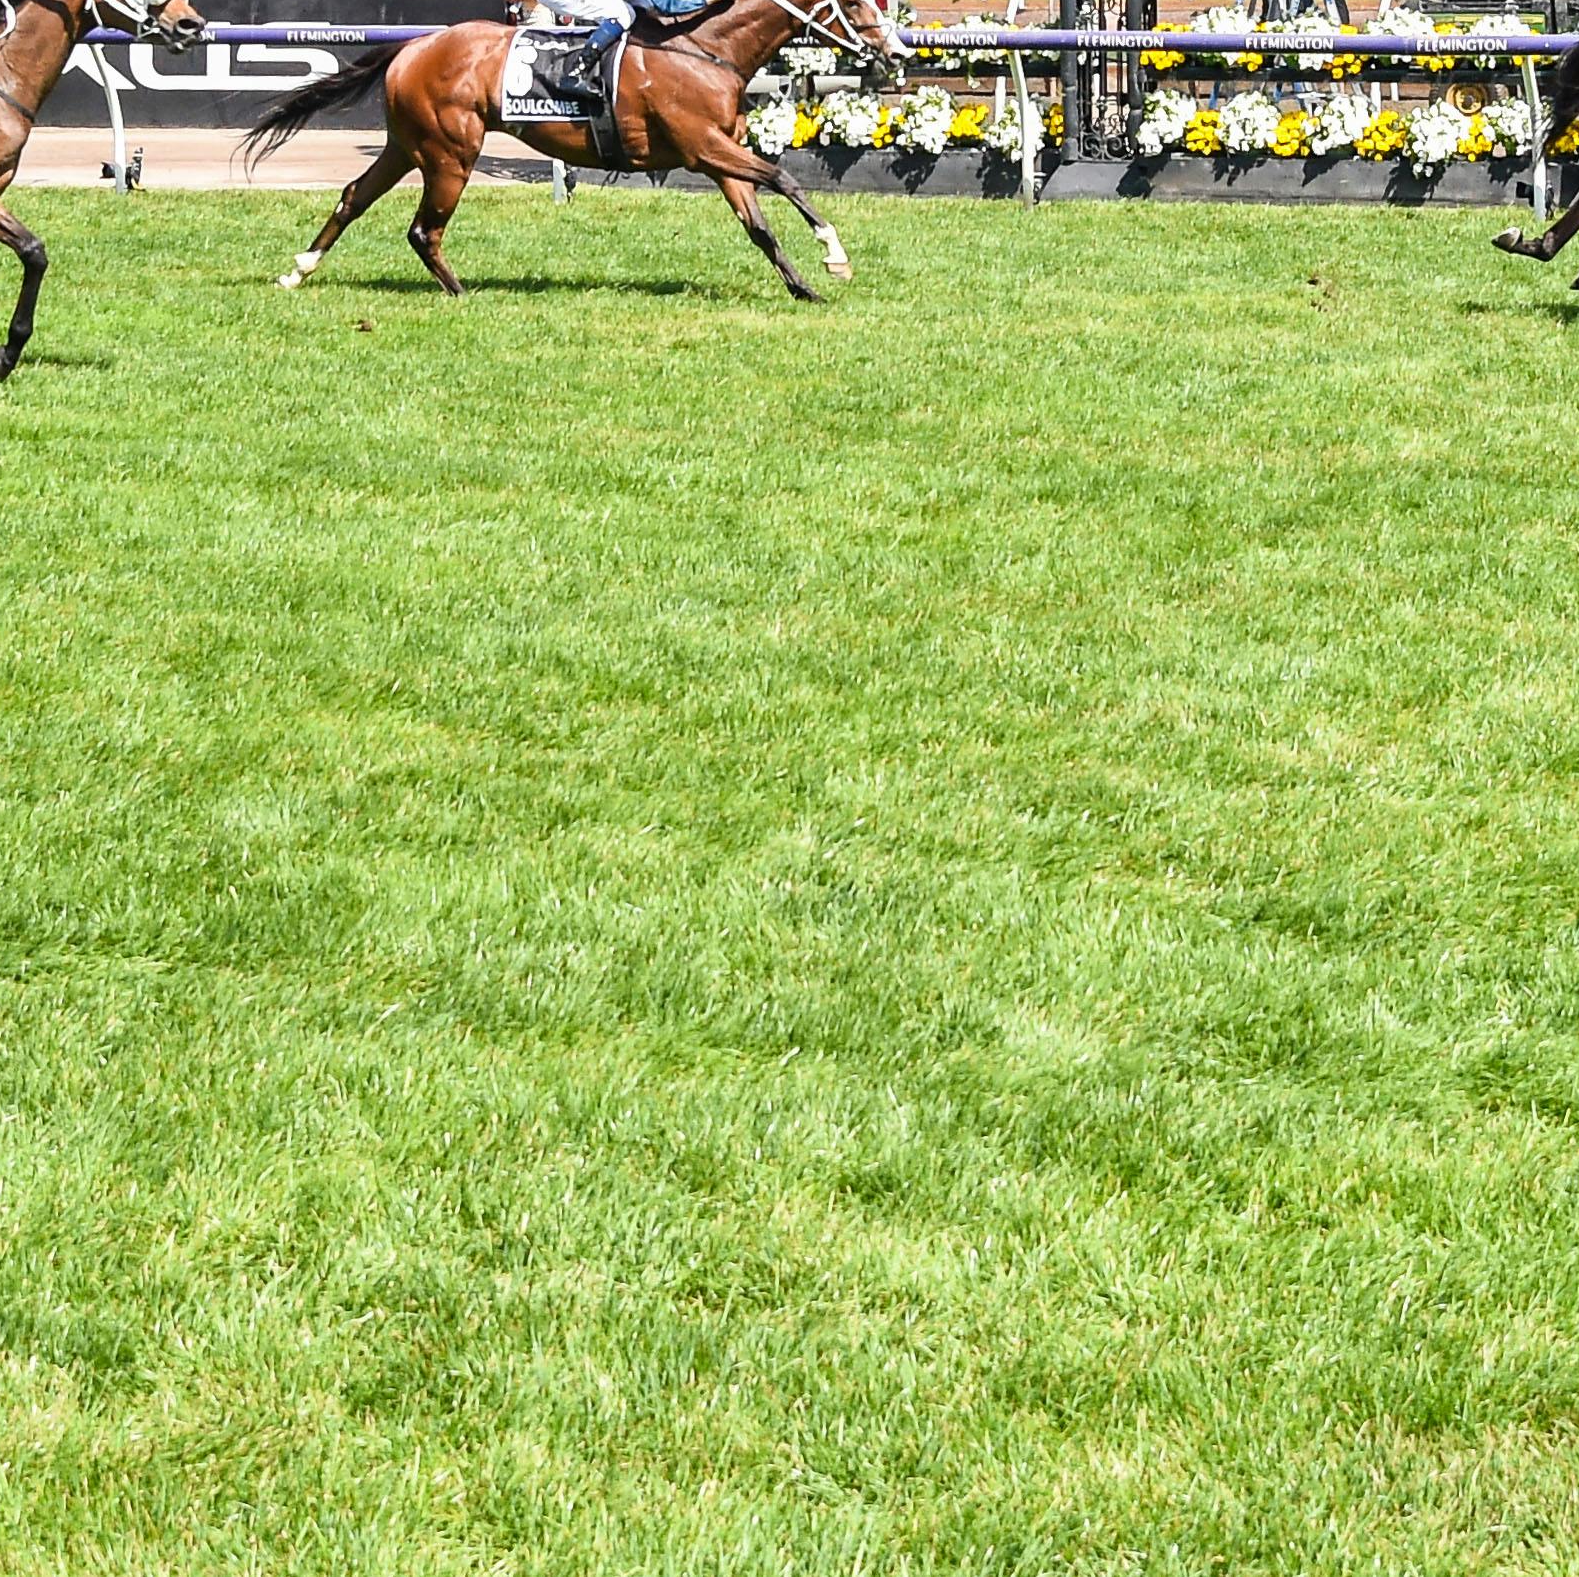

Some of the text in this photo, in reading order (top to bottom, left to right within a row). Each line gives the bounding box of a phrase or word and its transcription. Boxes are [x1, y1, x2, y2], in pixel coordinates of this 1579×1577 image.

[286, 30, 366, 43] FLEMINGTON
[911, 32, 999, 46] FLEMINGTON
[1076, 34, 1165, 48] FLEMINGTON
[1244, 36, 1335, 50] FLEMINGTON
[1416, 37, 1508, 52] FLEMINGTON
[506, 97, 581, 115] SOULCOMBE
